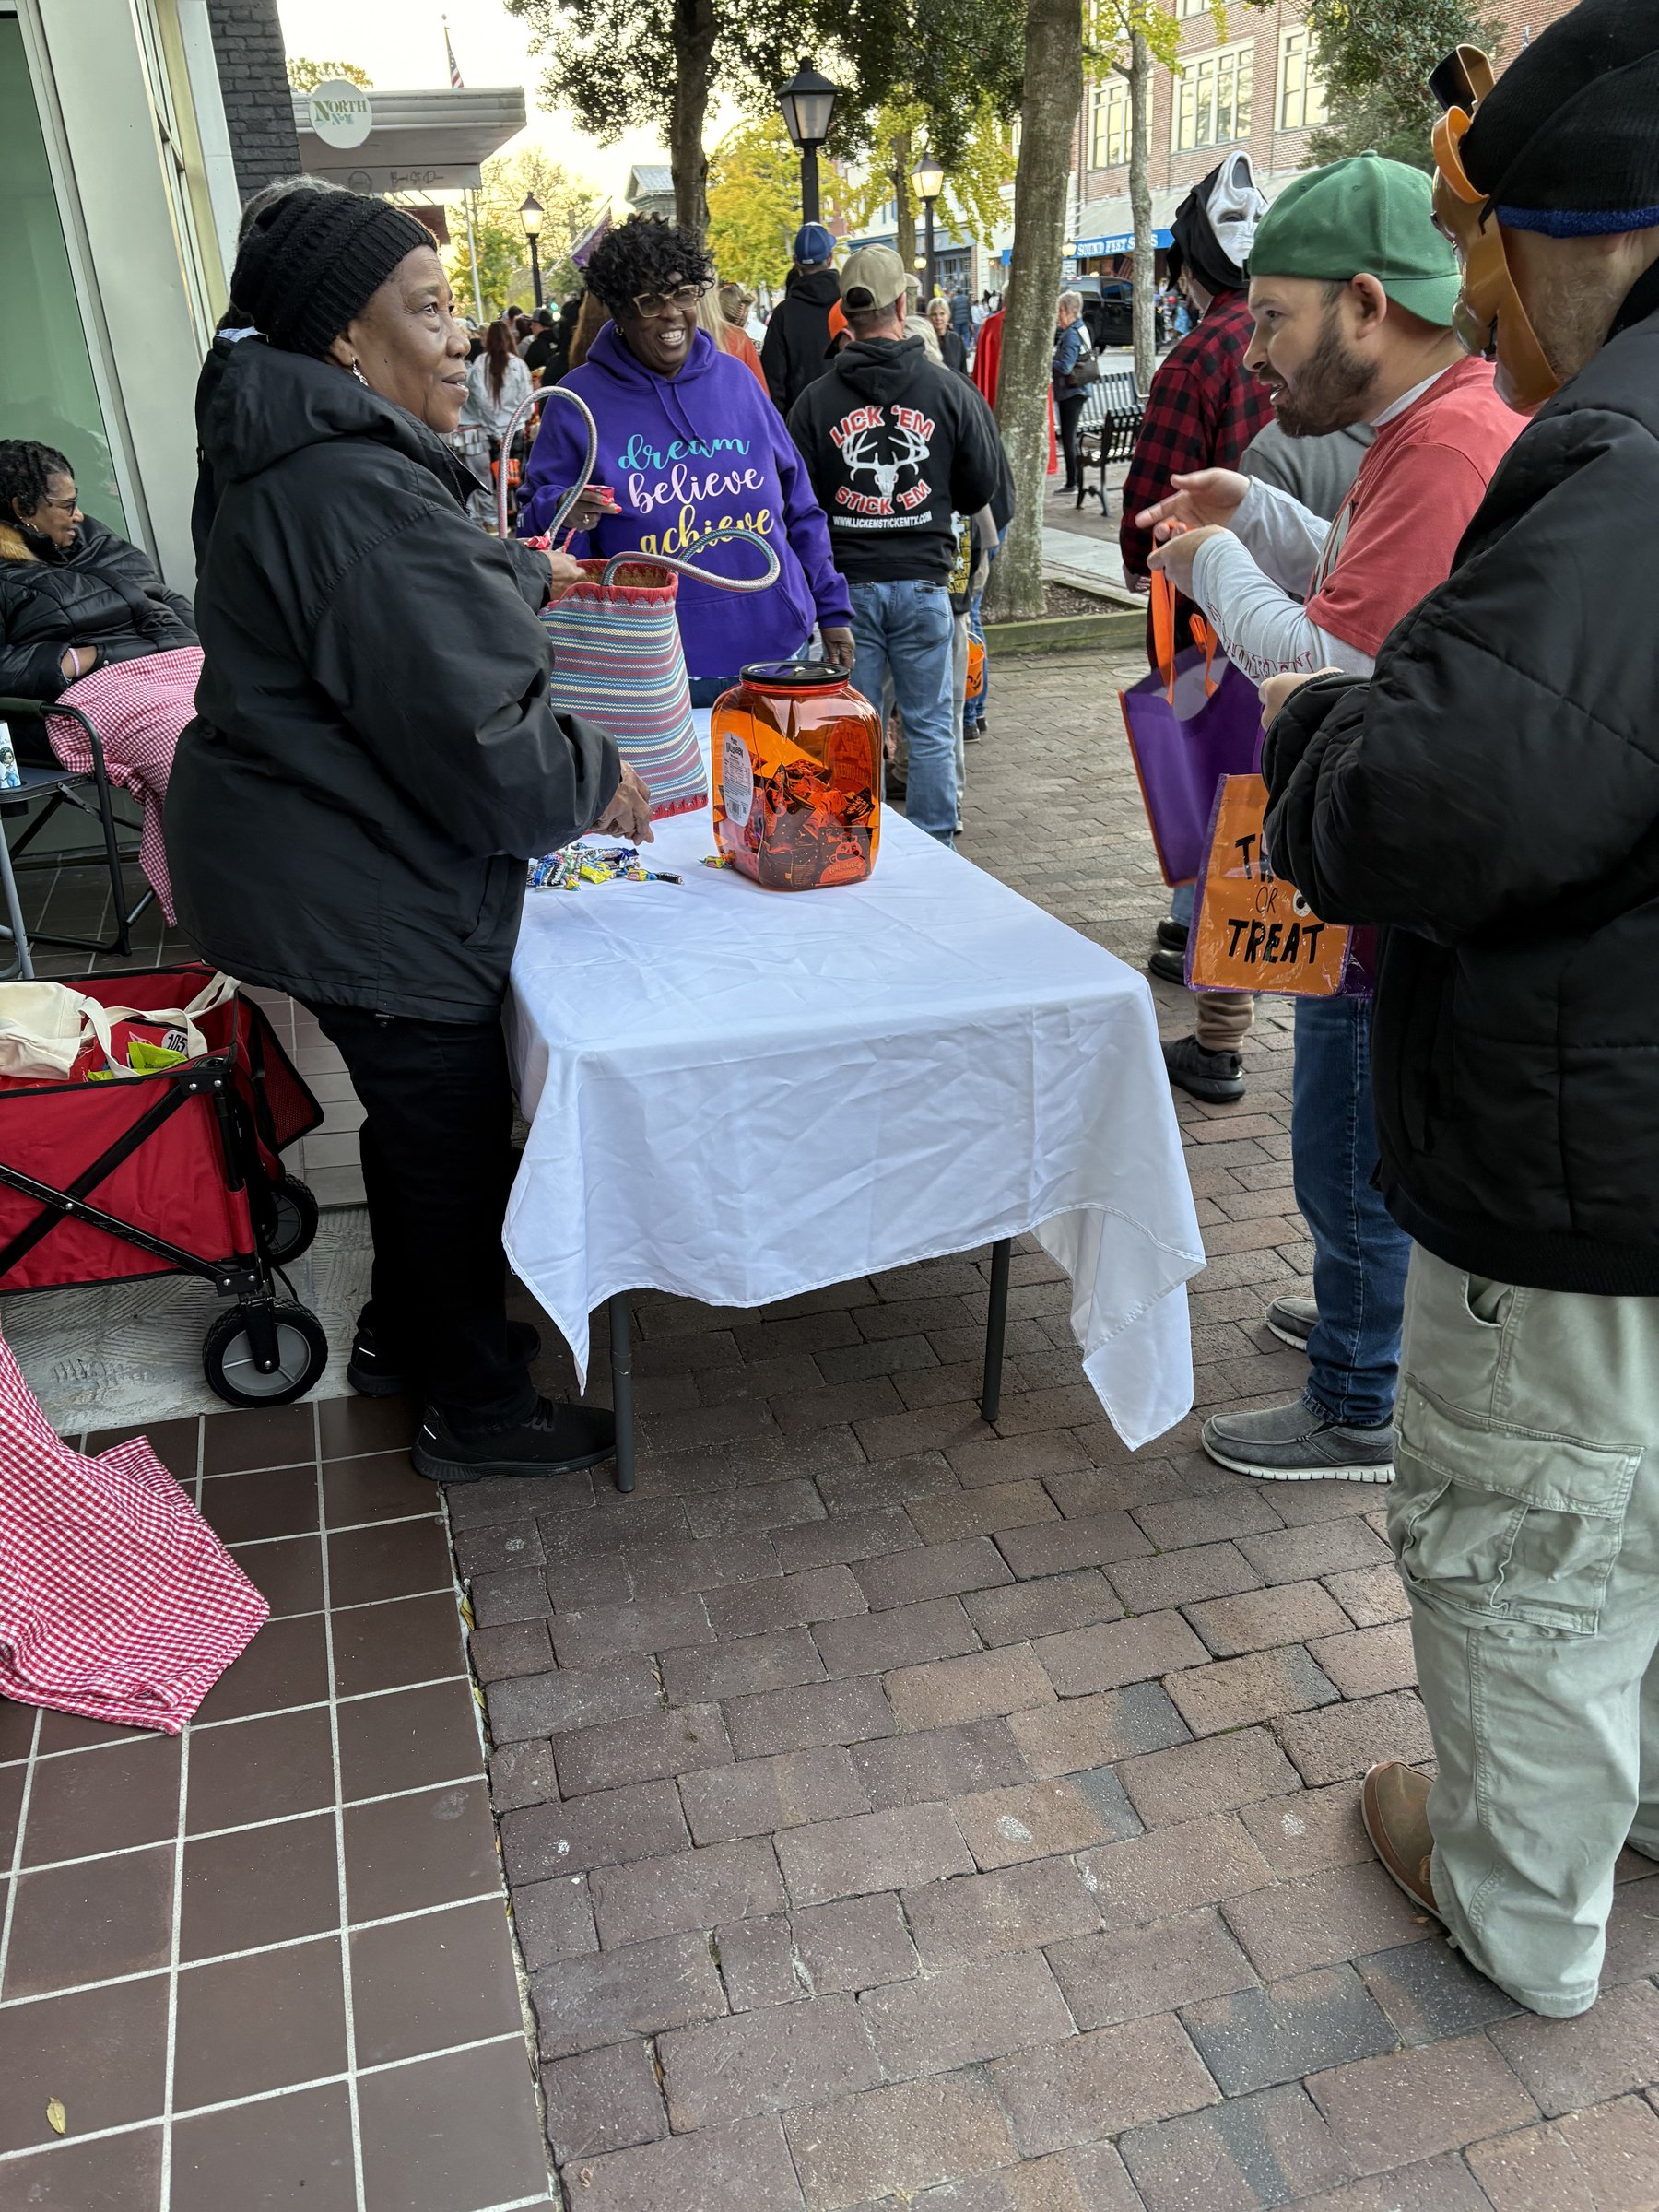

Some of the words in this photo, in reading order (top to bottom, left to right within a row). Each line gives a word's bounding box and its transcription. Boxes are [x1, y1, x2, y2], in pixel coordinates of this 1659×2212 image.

[313, 100, 367, 121] NORTH
[830, 406, 885, 448] LICK
[618, 434, 750, 470] dream
[629, 464, 764, 513] believe
[835, 486, 895, 515] STICK
[833, 511, 933, 528] WWW.LICKEMSTICKEMTX.COM
[1255, 886, 1278, 913] OR
[1228, 918, 1325, 964] TREAT
[168, 1033, 188, 1053] 105
